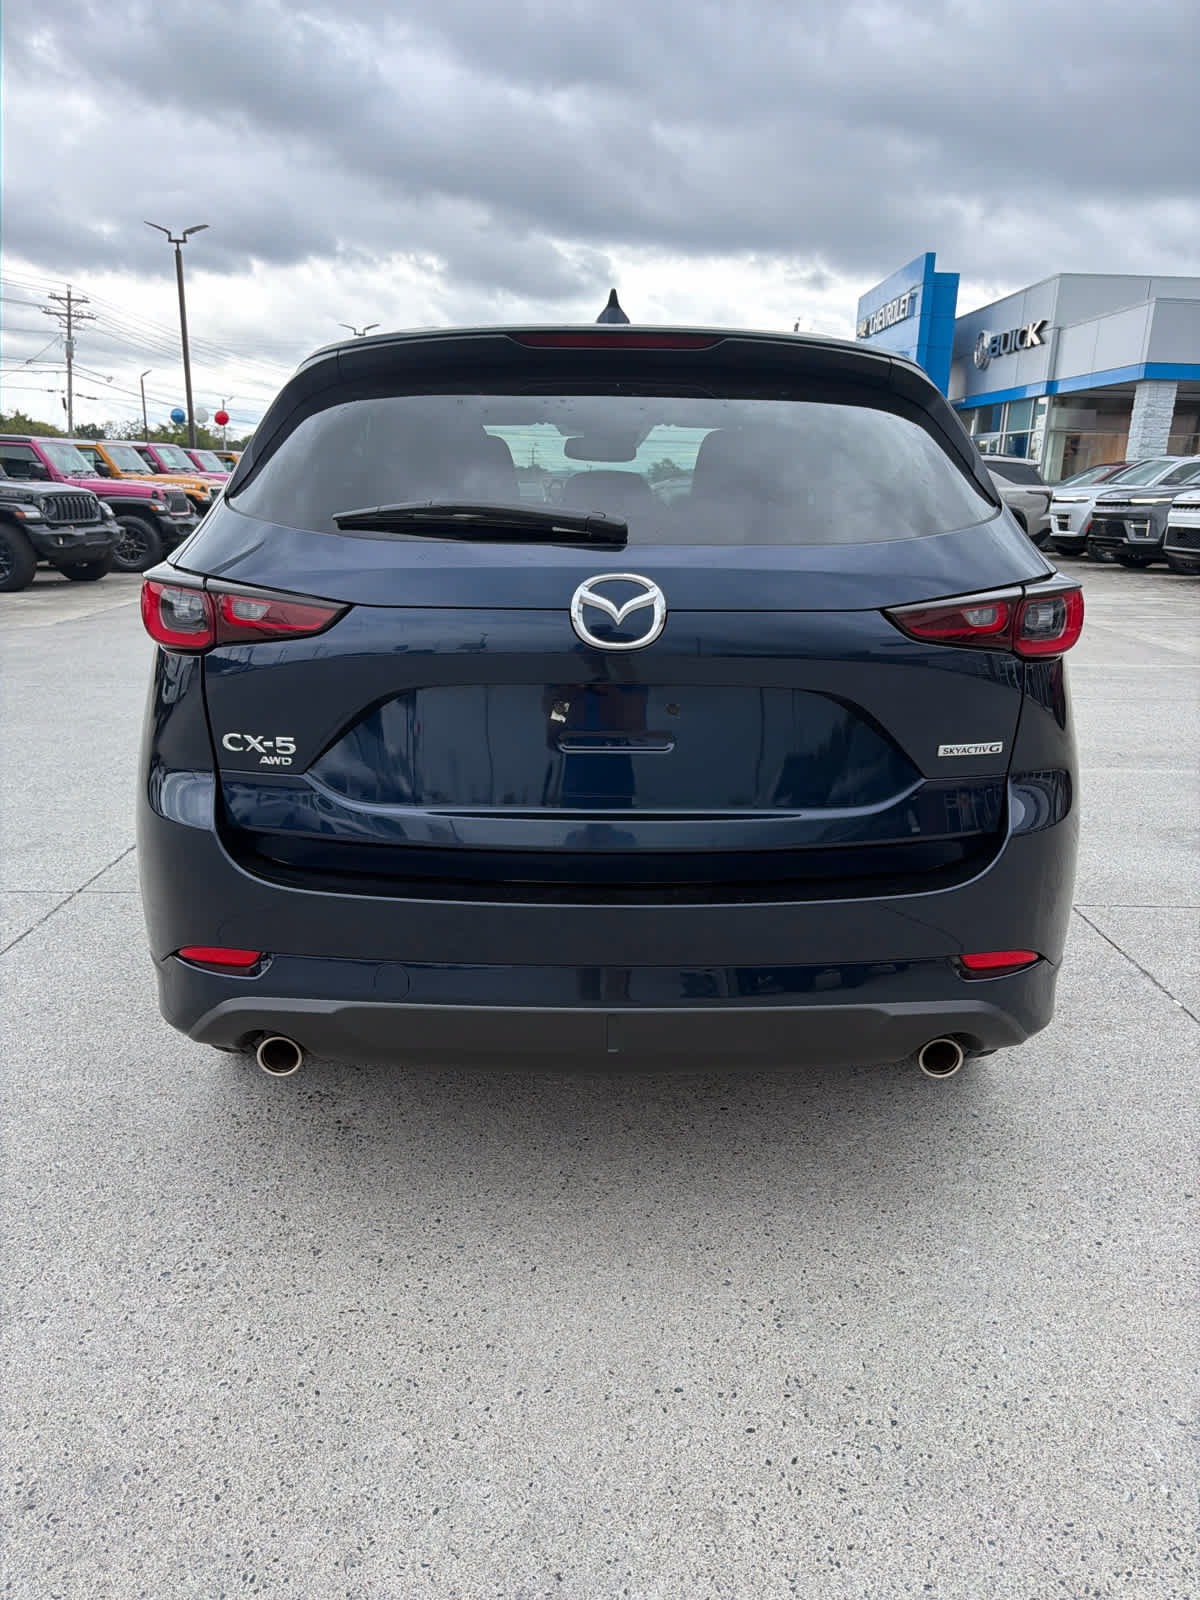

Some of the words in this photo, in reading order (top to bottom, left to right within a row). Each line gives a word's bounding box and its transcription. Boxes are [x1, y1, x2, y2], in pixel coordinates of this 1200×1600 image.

[870, 292, 912, 335] CHEVROLET
[988, 320, 1046, 357] BUICK
[222, 733, 297, 755] CX-5
[259, 756, 293, 766] AWD
